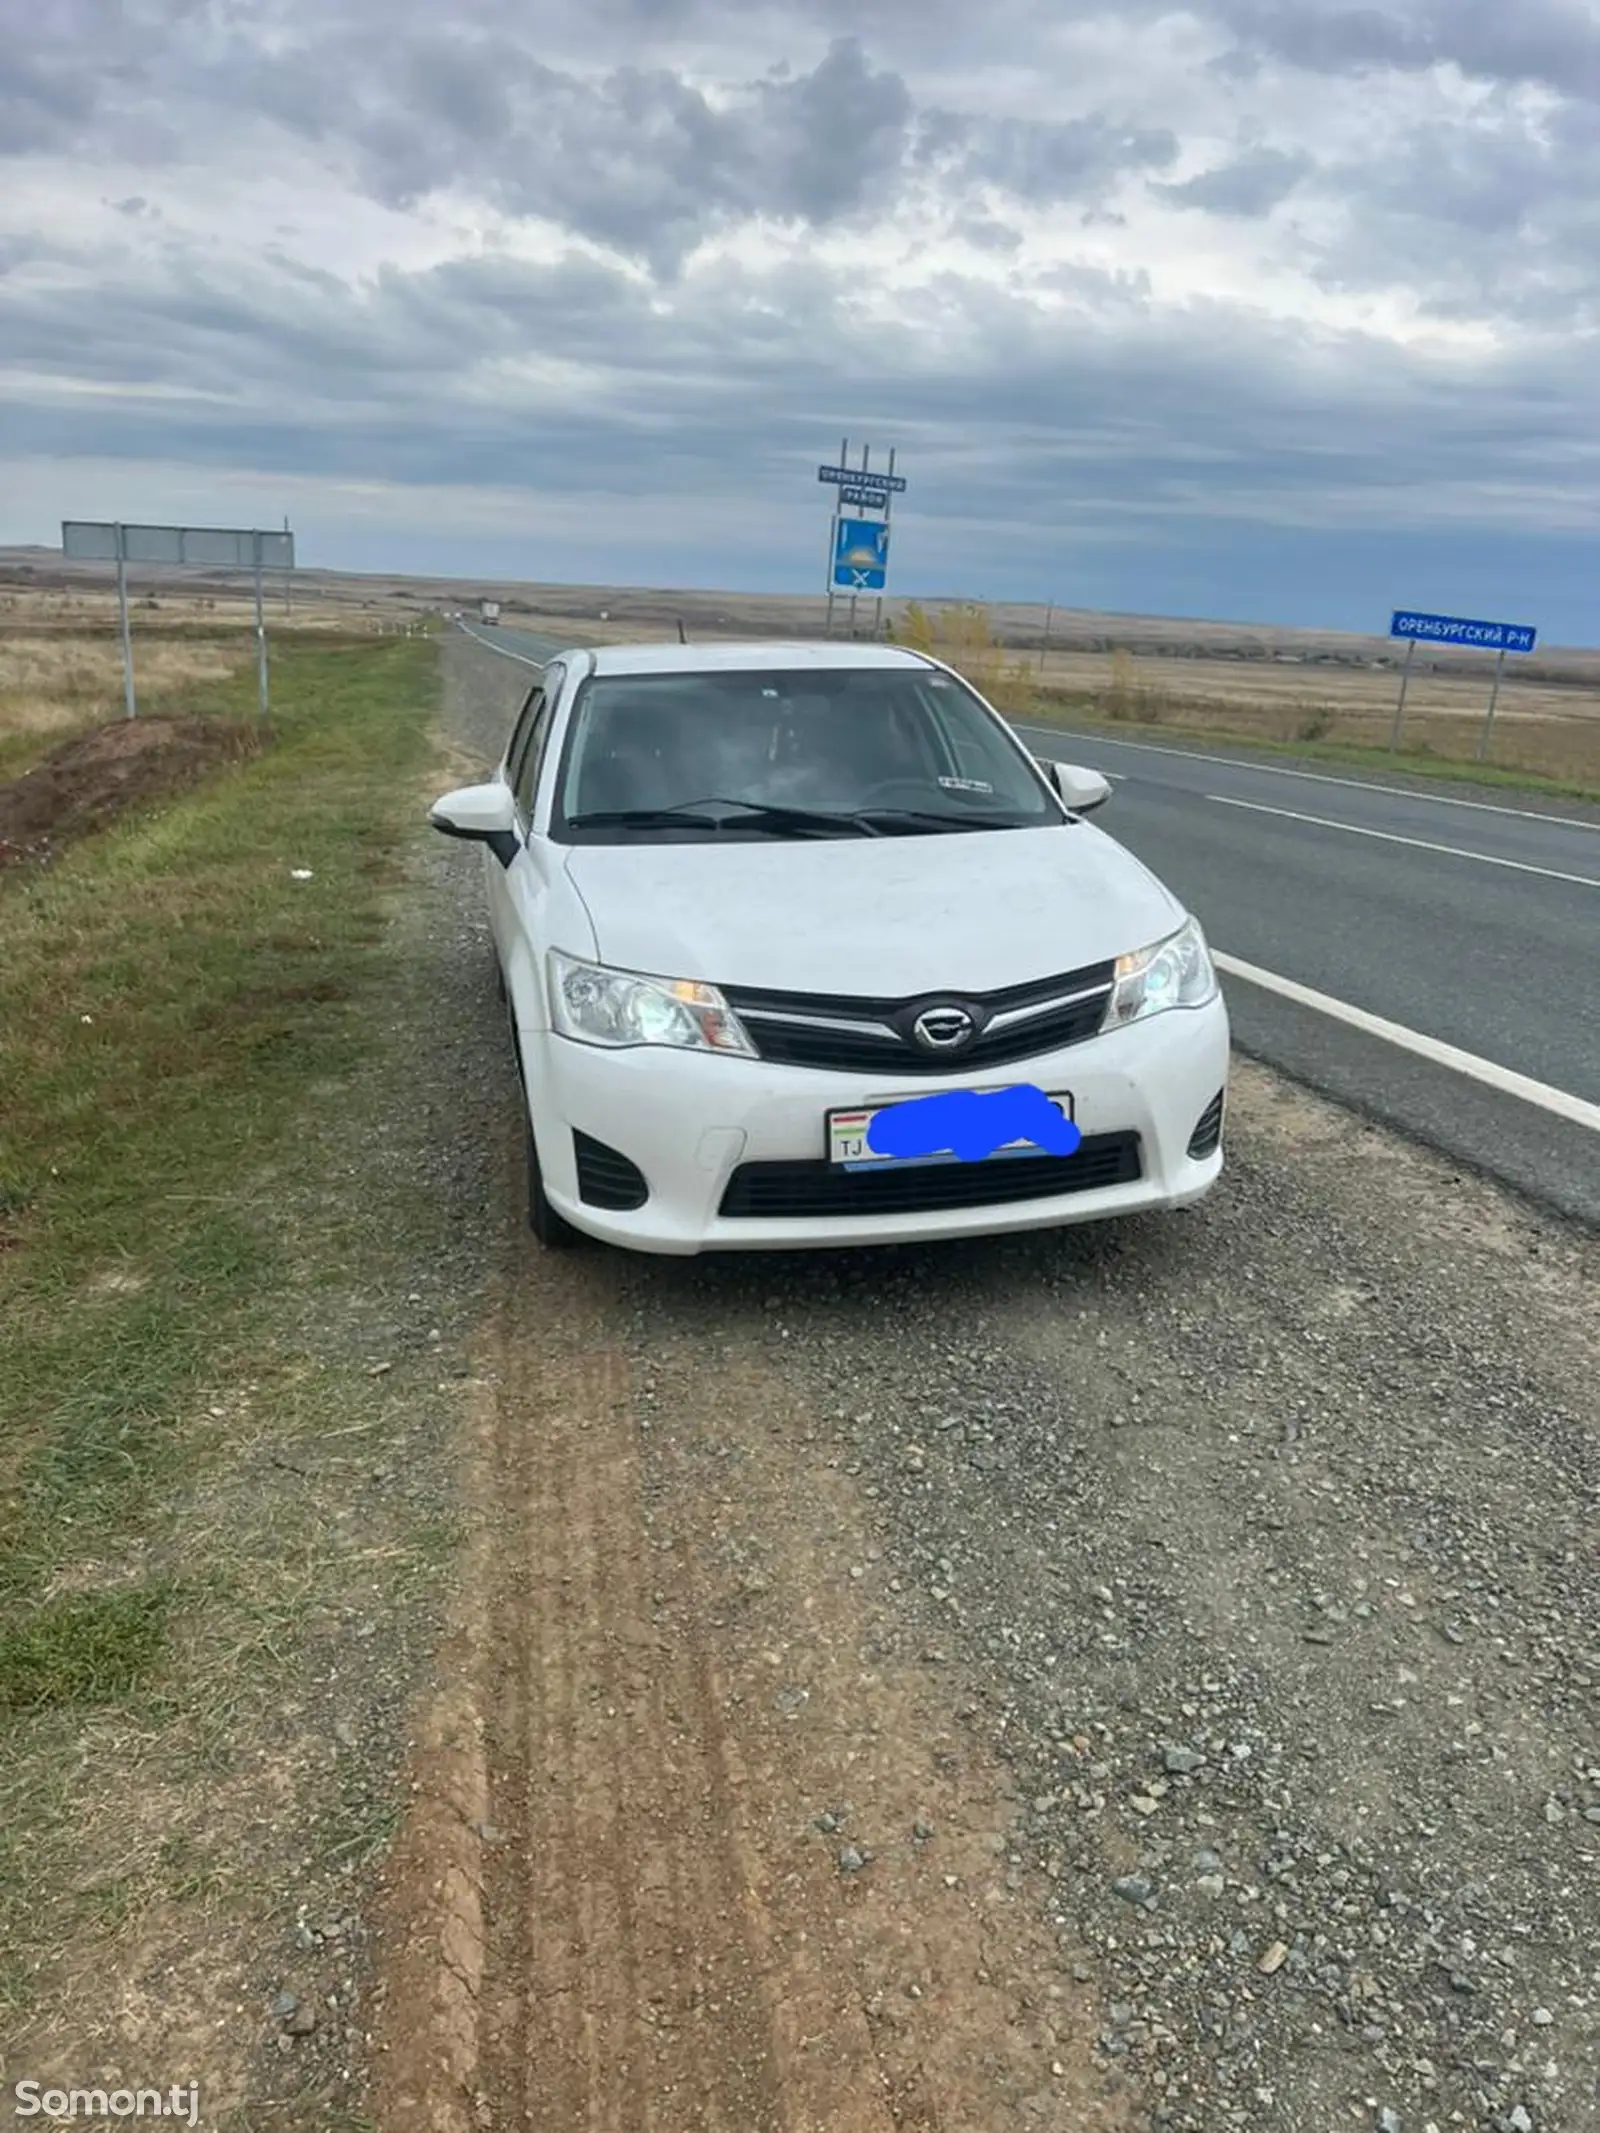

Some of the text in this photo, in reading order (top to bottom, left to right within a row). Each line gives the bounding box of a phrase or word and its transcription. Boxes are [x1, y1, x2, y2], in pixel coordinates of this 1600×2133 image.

[1398, 616, 1531, 646] ОРЕНБУРГСКИЙ Р-Н
[840, 1139, 863, 1157] TJ
